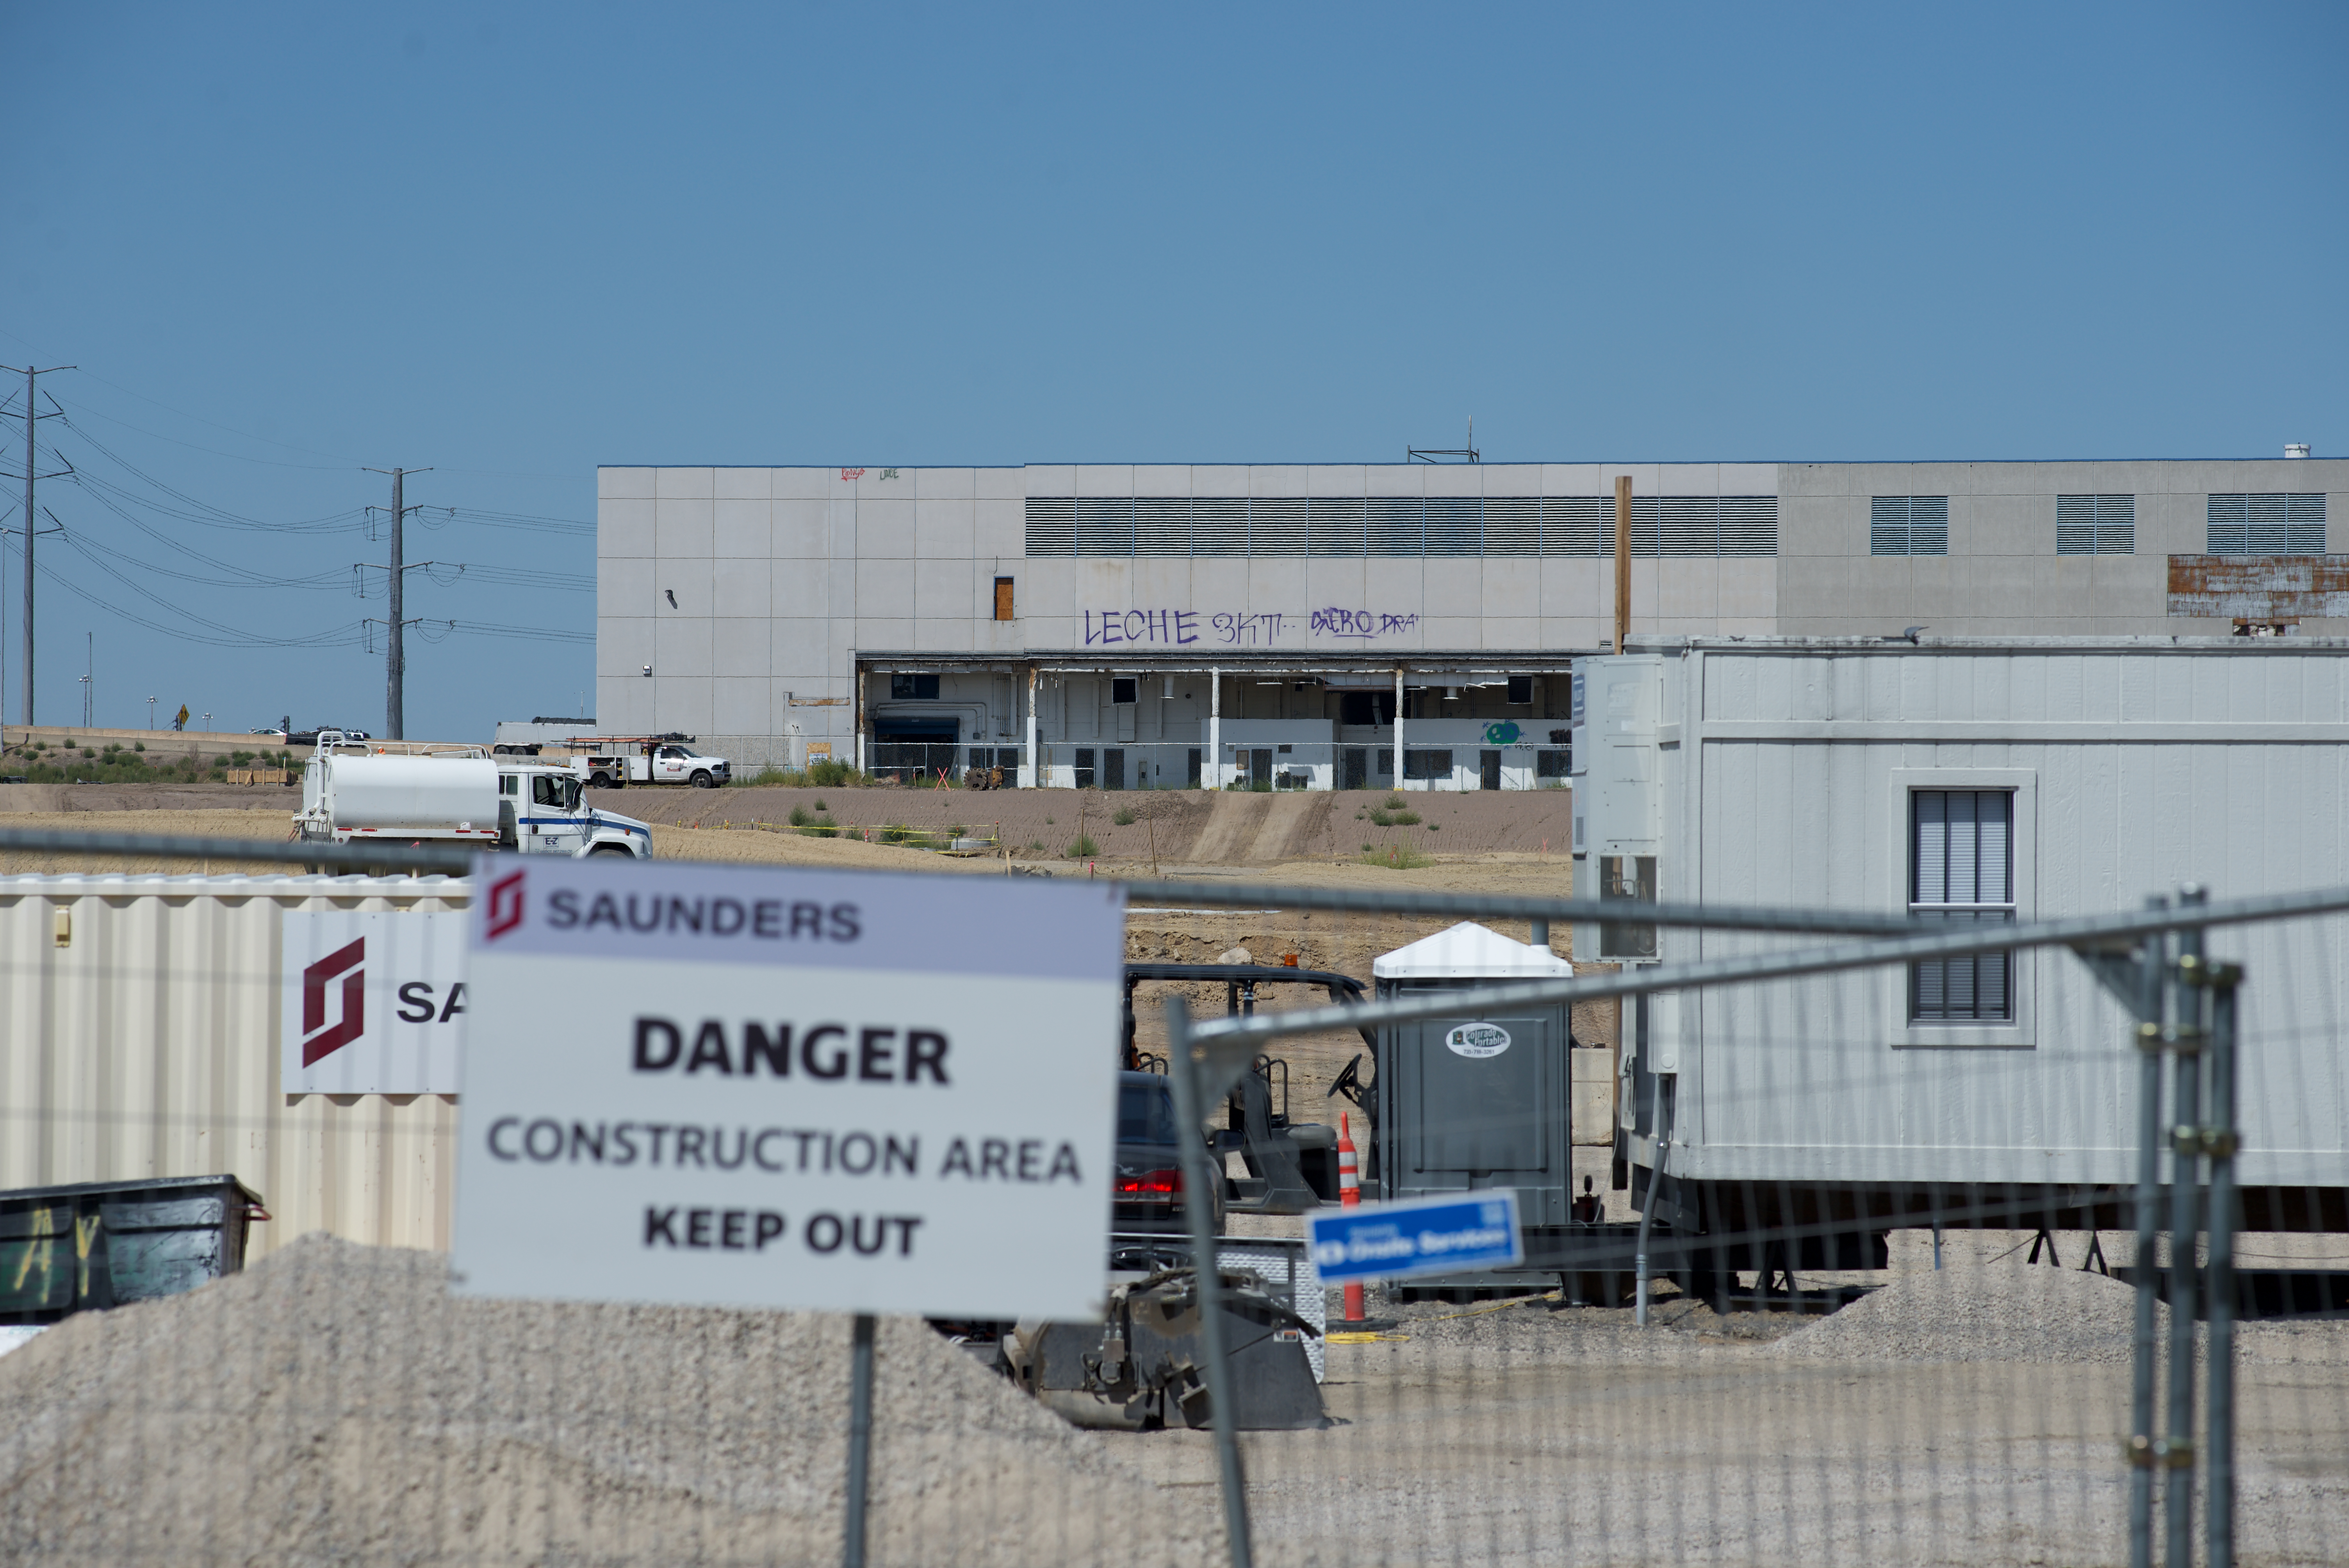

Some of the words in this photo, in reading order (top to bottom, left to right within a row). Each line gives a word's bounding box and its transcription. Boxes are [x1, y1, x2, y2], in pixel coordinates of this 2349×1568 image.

[1085, 609, 1201, 644] LECHE
[547, 888, 863, 944] SAUNDERS
[631, 1016, 951, 1086] DANGER
[1466, 1028, 1497, 1040] Colorado
[487, 1116, 921, 1178] CONSTRUCTION
[940, 1137, 1082, 1185] AREA
[642, 1205, 785, 1253] KEEP
[803, 1211, 923, 1258] OUT
